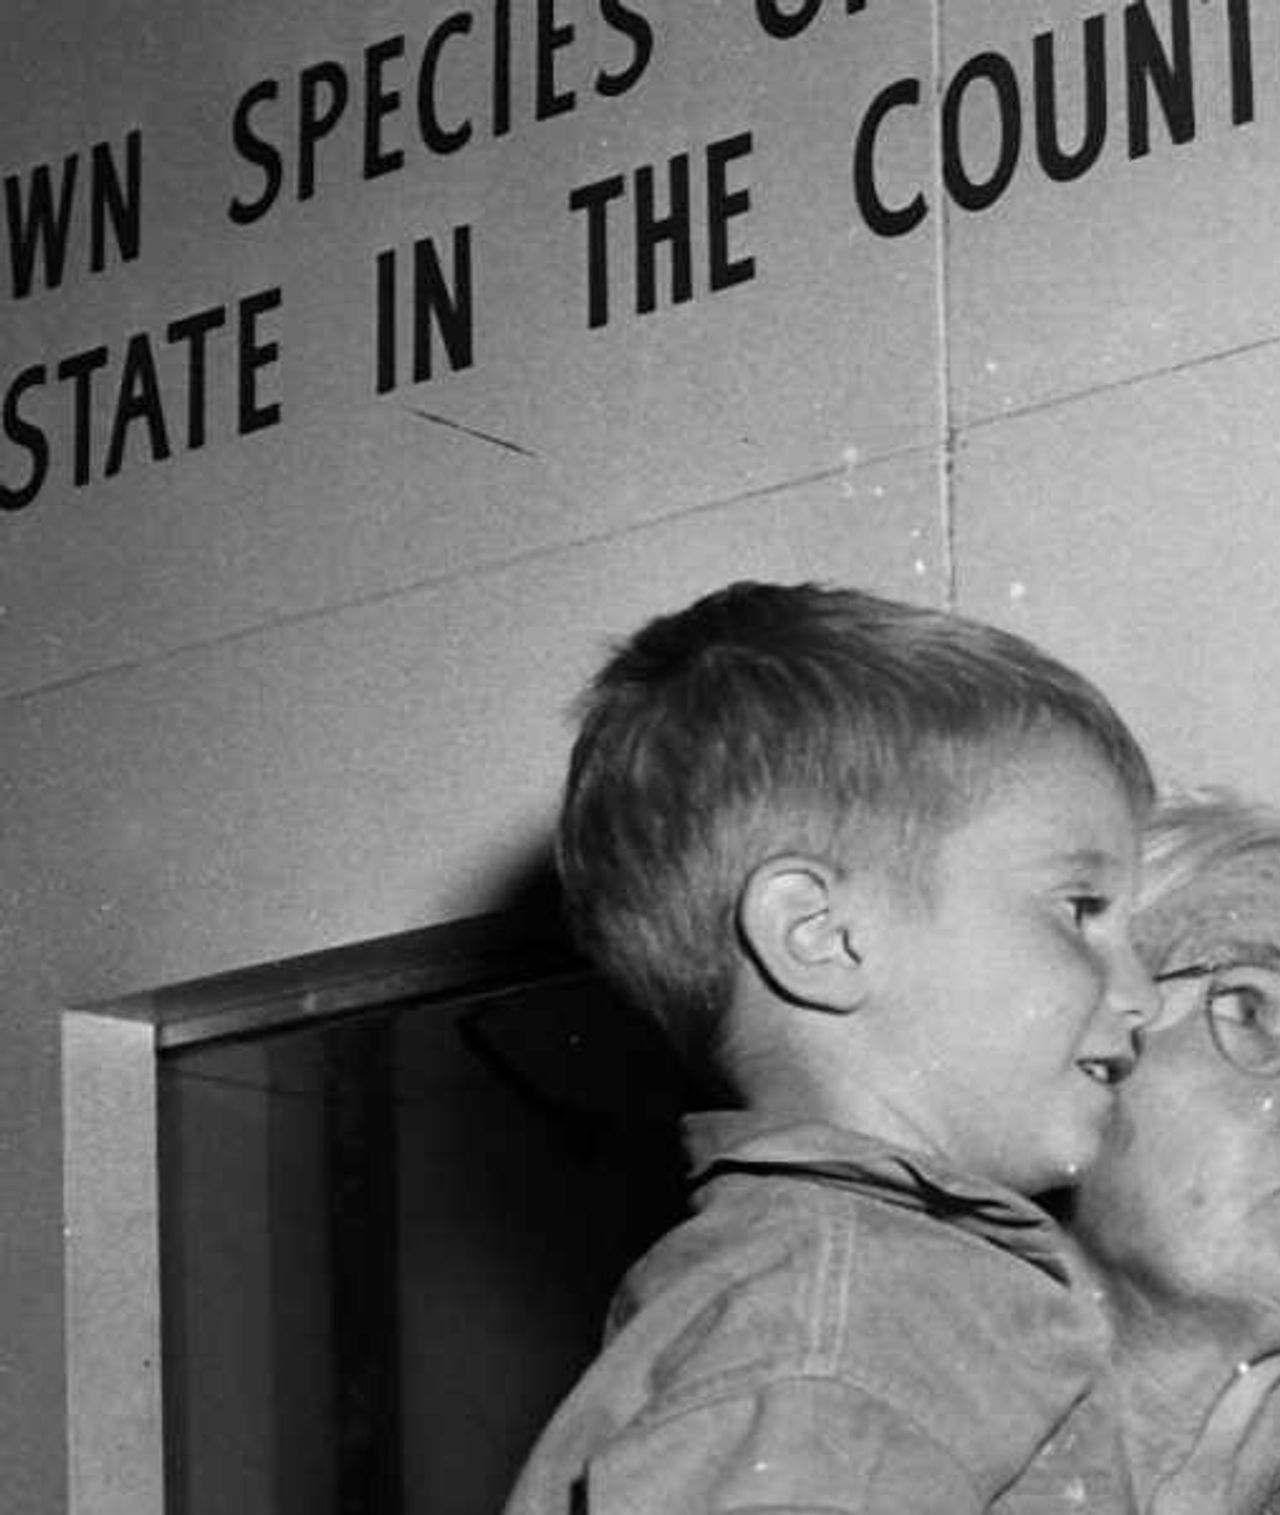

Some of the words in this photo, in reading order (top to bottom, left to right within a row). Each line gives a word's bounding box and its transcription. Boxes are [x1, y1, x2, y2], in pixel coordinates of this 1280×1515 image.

[226, 0, 655, 226] SPECIES
[0, 286, 284, 513] STATE
[376, 223, 474, 396] IN
[568, 131, 756, 330] THE
